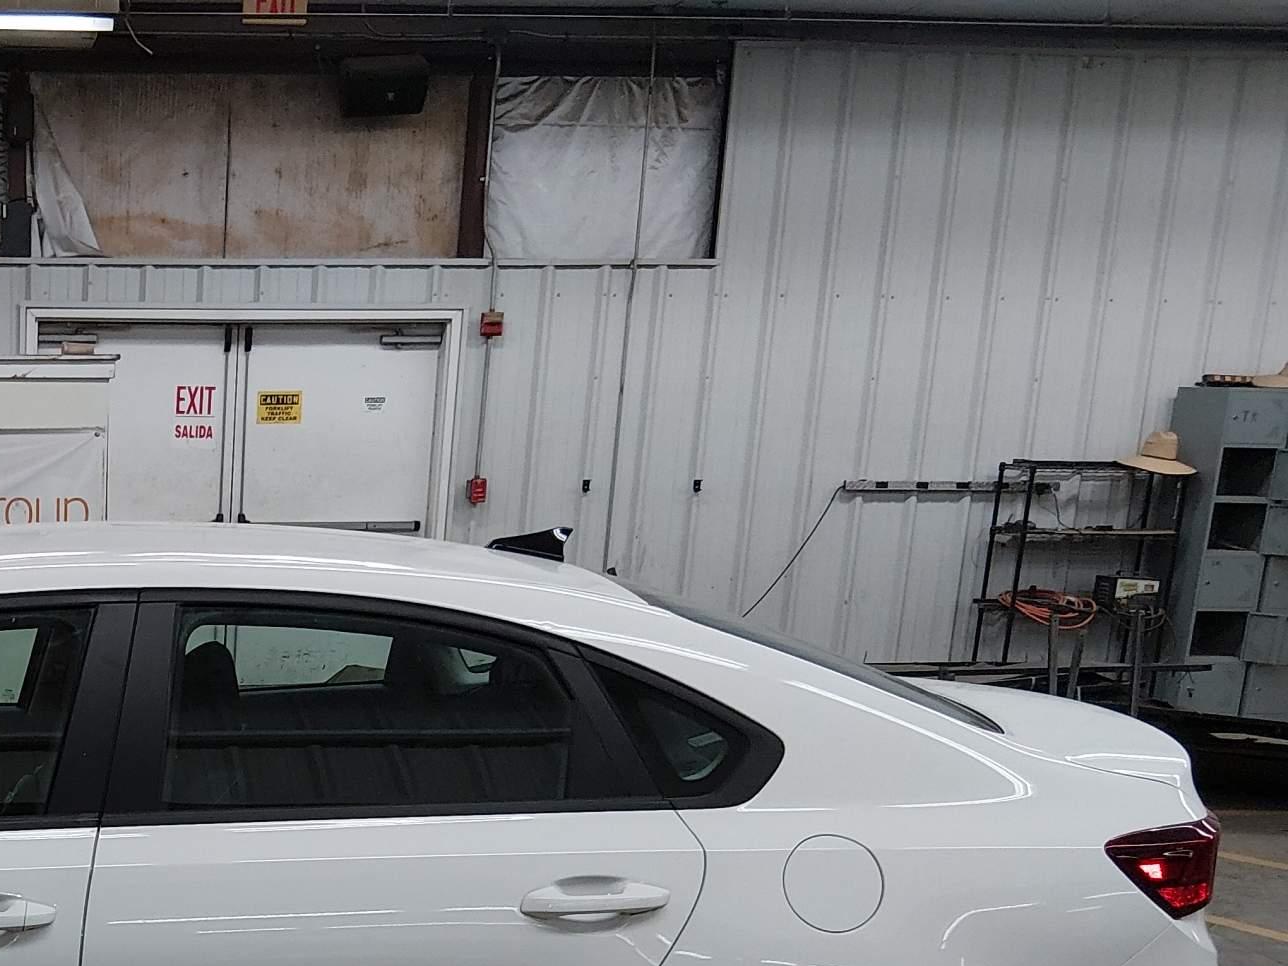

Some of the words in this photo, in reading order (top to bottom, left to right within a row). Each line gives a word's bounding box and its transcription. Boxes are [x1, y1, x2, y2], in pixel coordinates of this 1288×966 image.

[176, 386, 216, 415] EXIT
[260, 395, 299, 404] CAUTION
[175, 424, 212, 439] SALIDA
